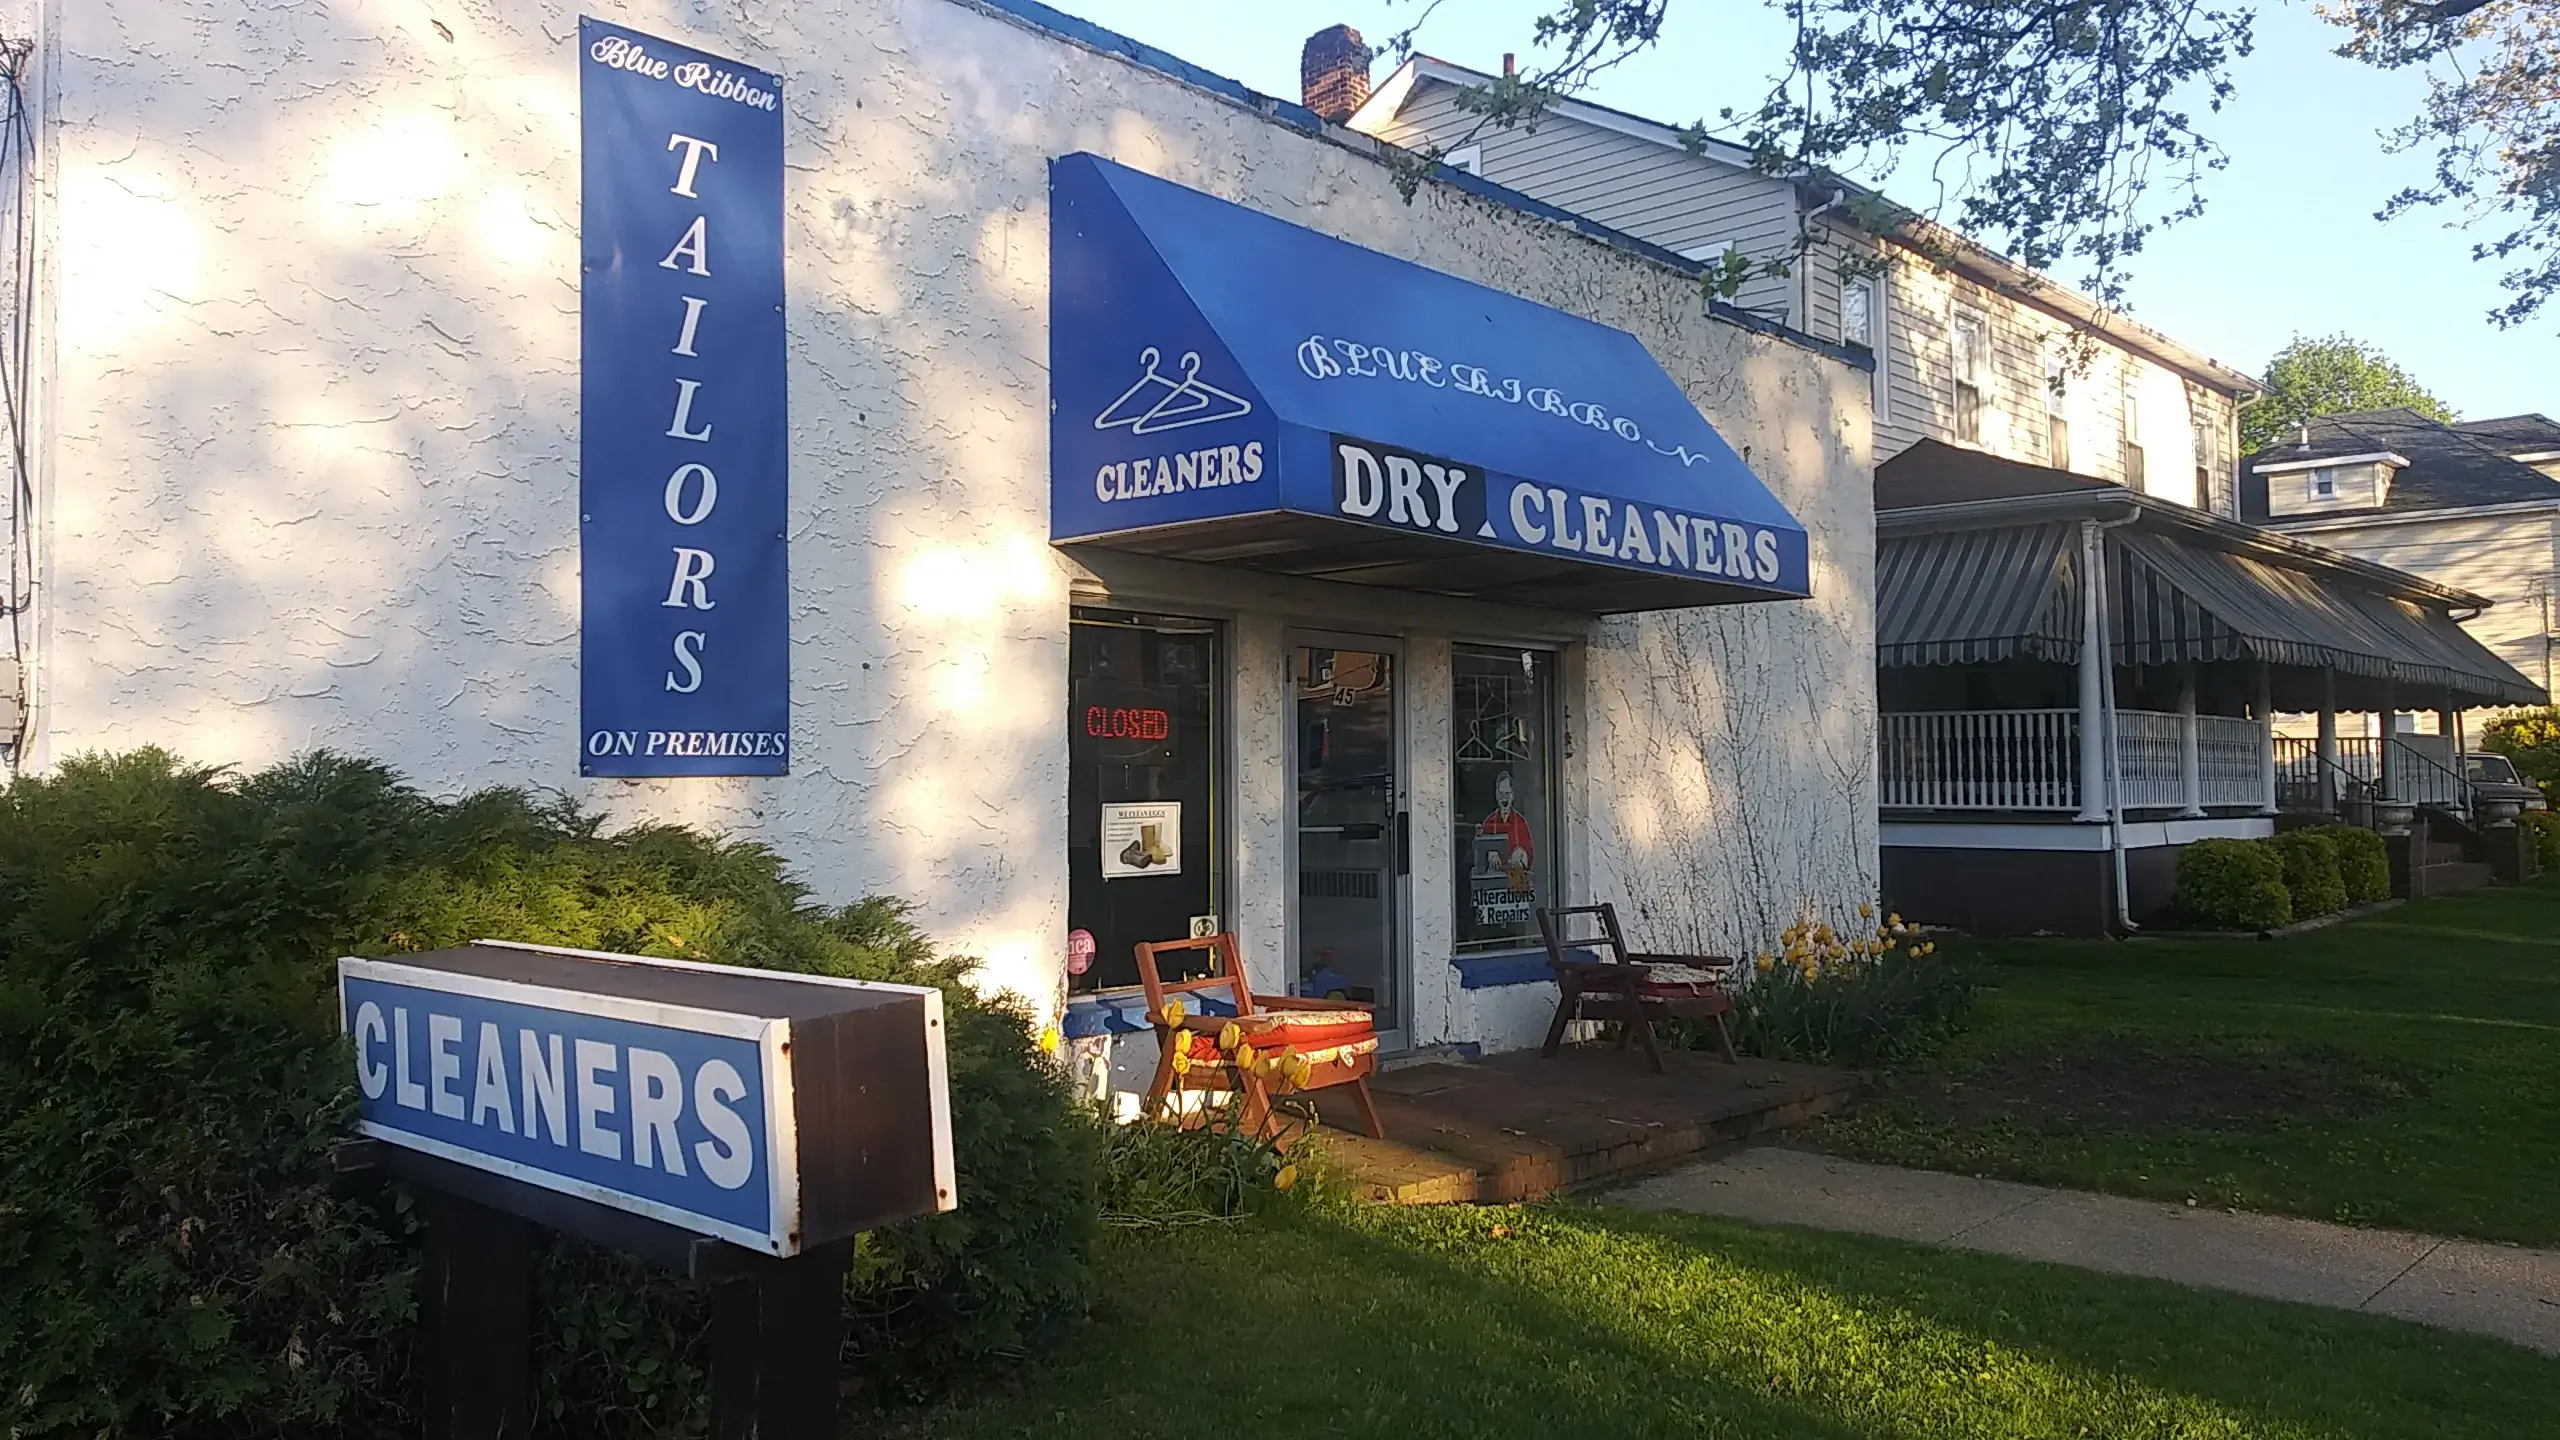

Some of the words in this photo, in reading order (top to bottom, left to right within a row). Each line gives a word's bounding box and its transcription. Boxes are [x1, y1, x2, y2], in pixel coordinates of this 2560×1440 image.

[591, 36, 668, 80] Blue
[674, 62, 777, 112] Ribbon
[660, 133, 718, 693] TAILORS
[1297, 334, 1445, 388] BLUE
[1451, 362, 1710, 468] RIBBON
[1096, 442, 1264, 502] CLEANERS
[1338, 444, 1467, 533] DRY
[1510, 482, 1780, 583] CLEANERS
[1087, 706, 1168, 739] CLOSED
[1335, 688, 1355, 705] 45
[588, 731, 638, 756] ON
[644, 732, 786, 756] PREMISES
[1472, 888, 1535, 906] Alterations
[1477, 908, 1485, 924] &
[1488, 904, 1530, 926] Repairs
[354, 1001, 753, 1190] CLEANERS
